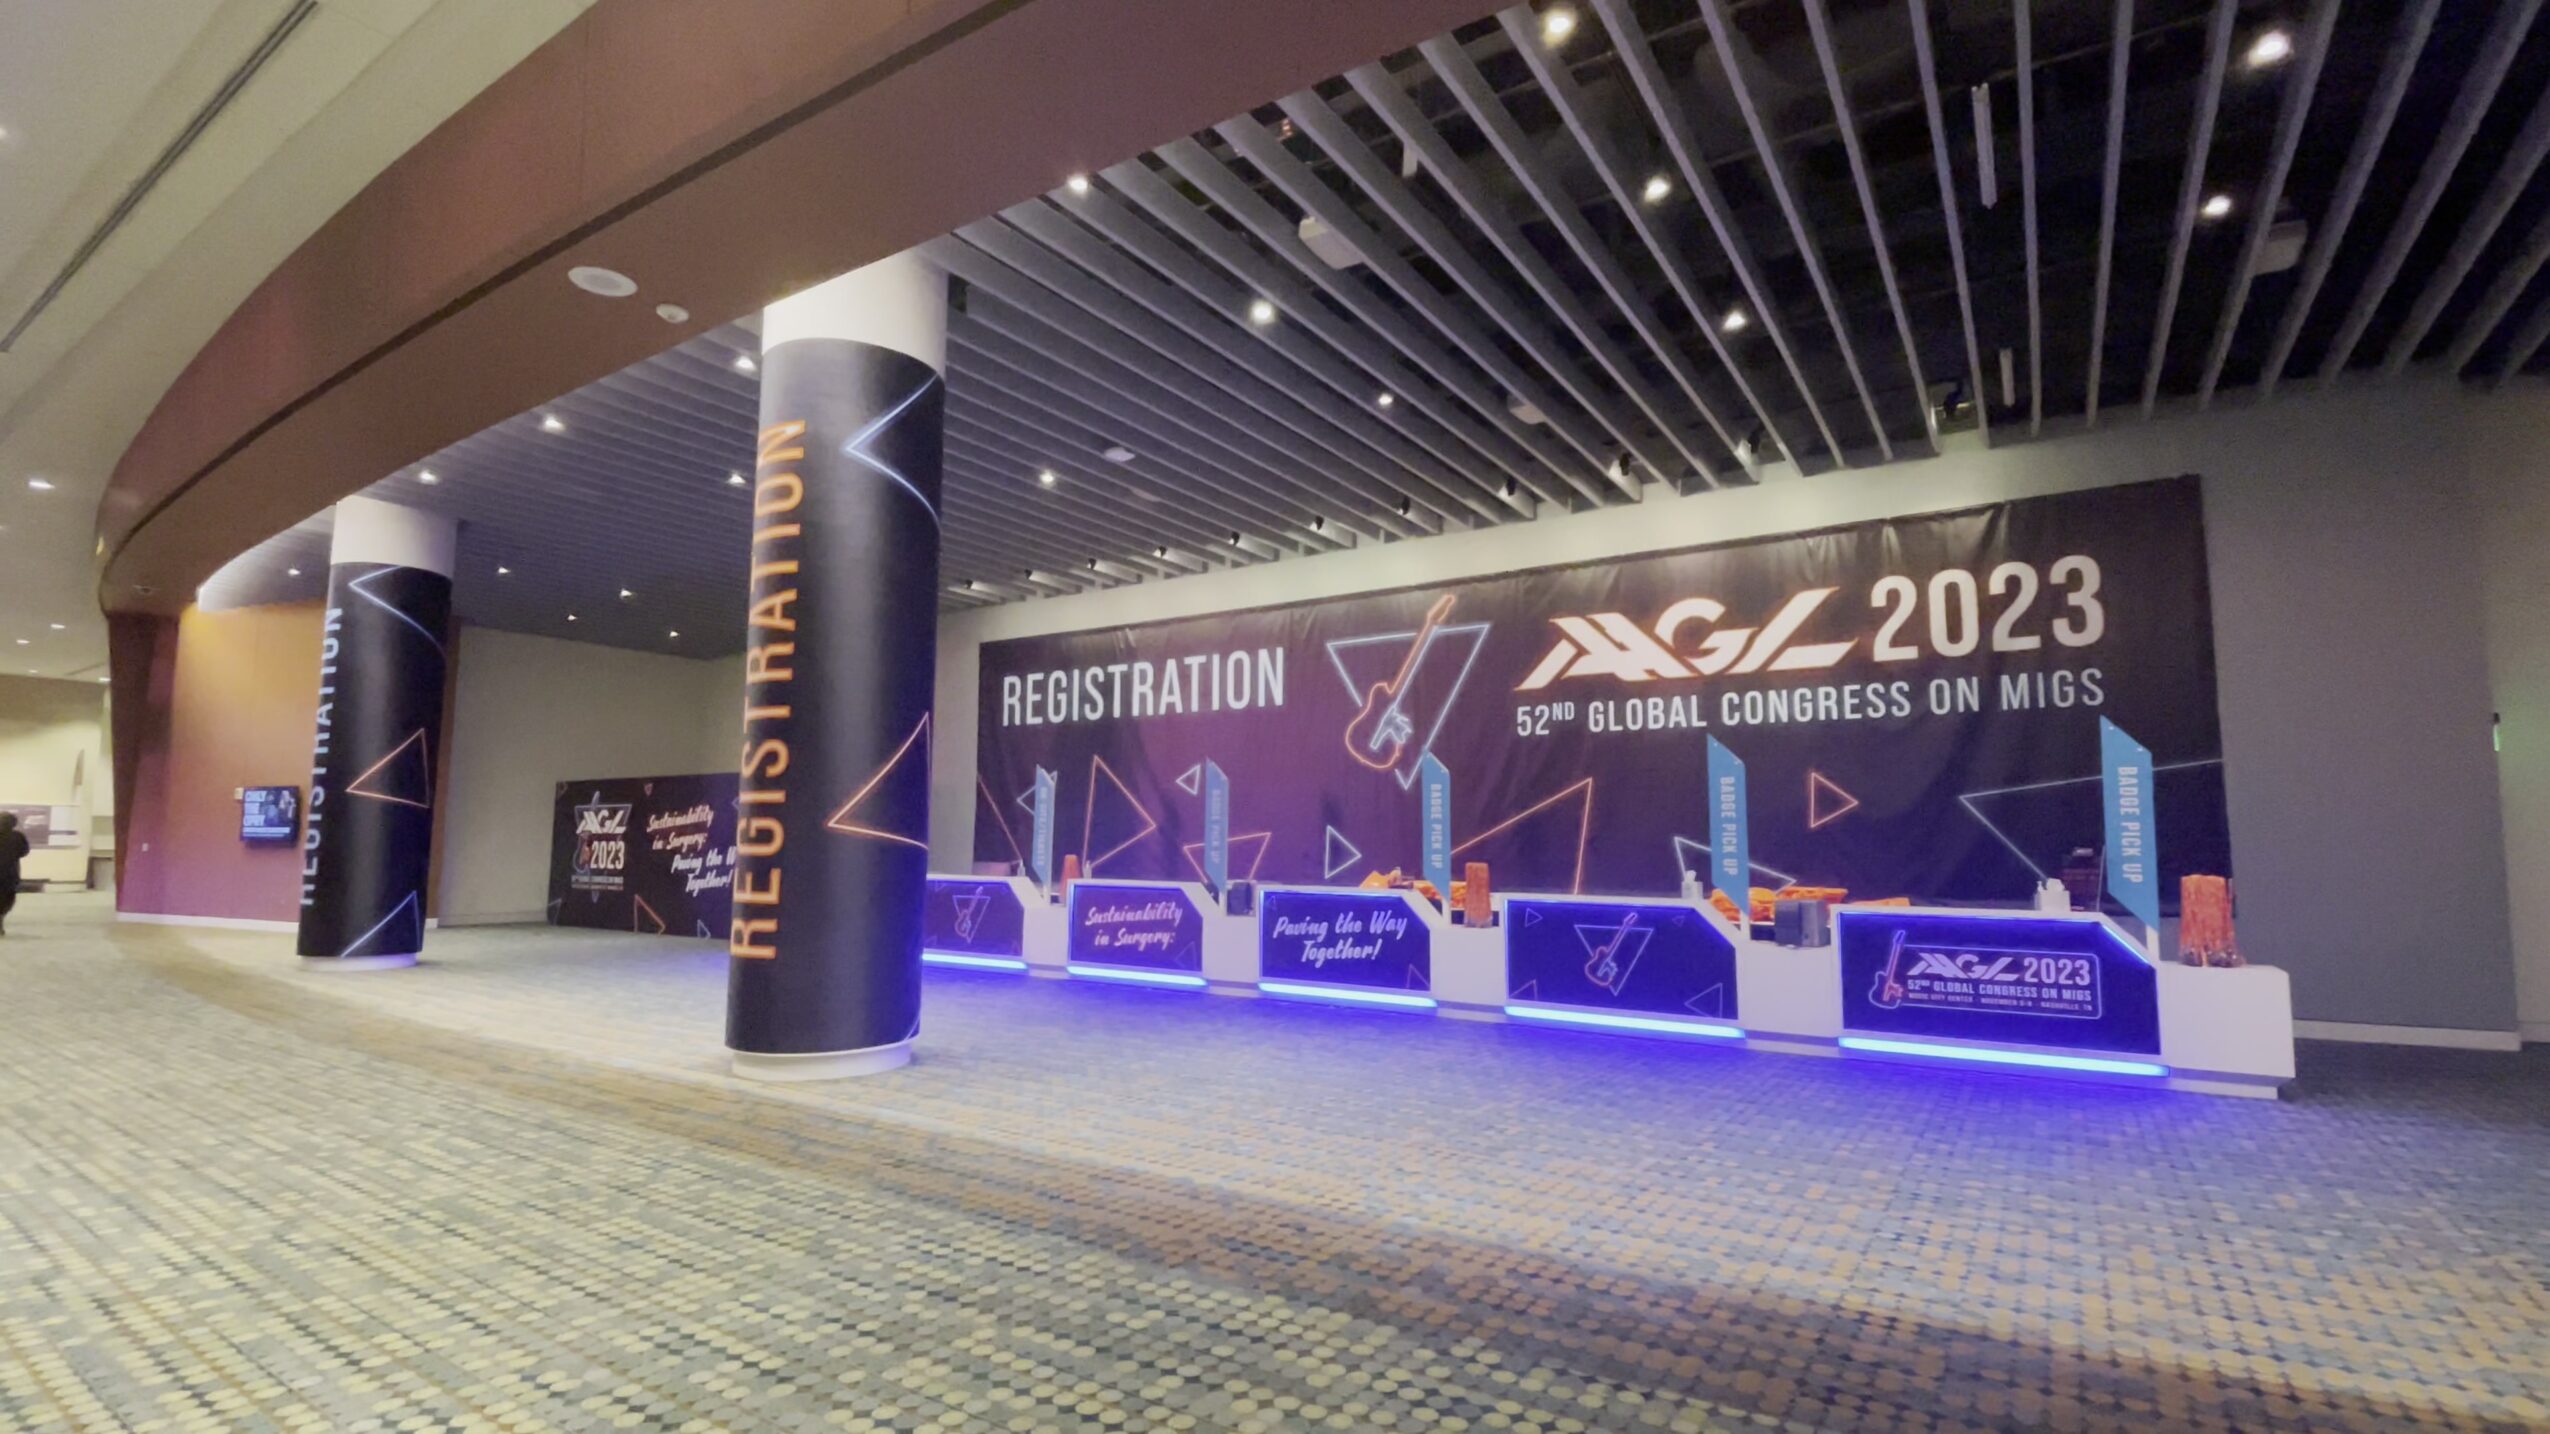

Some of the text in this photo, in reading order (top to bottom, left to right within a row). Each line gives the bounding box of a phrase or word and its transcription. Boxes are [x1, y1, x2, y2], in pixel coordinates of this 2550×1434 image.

[1514, 555, 2105, 691] AAGL 2023
[729, 420, 806, 960] REGISTRATION
[1002, 646, 1285, 726] REGISTRATION
[1516, 668, 2105, 737] 52ND GLOBAL CONGRESS ON MIGS
[646, 804, 714, 832] Sustainability
[1720, 776, 1739, 875] BADGE PICK UP
[2117, 767, 2143, 883] BADGE PICK UP
[590, 841, 625, 869] 2023
[652, 835, 665, 850] in
[671, 853, 703, 874] Paving
[706, 849, 723, 867] the
[685, 869, 733, 897] Together!
[1085, 901, 1183, 927] Sustainability
[1273, 910, 1407, 942] Paving the Way
[1095, 928, 1176, 951] in Surgery:
[1301, 937, 1382, 969] Together!
[1907, 952, 2091, 986] AAGL 2023
[1933, 981, 1975, 994] GLOBAL
[1979, 984, 2038, 999] CONGRESS
[2042, 987, 2058, 999] ON
[2062, 988, 2092, 1002] MIGS
